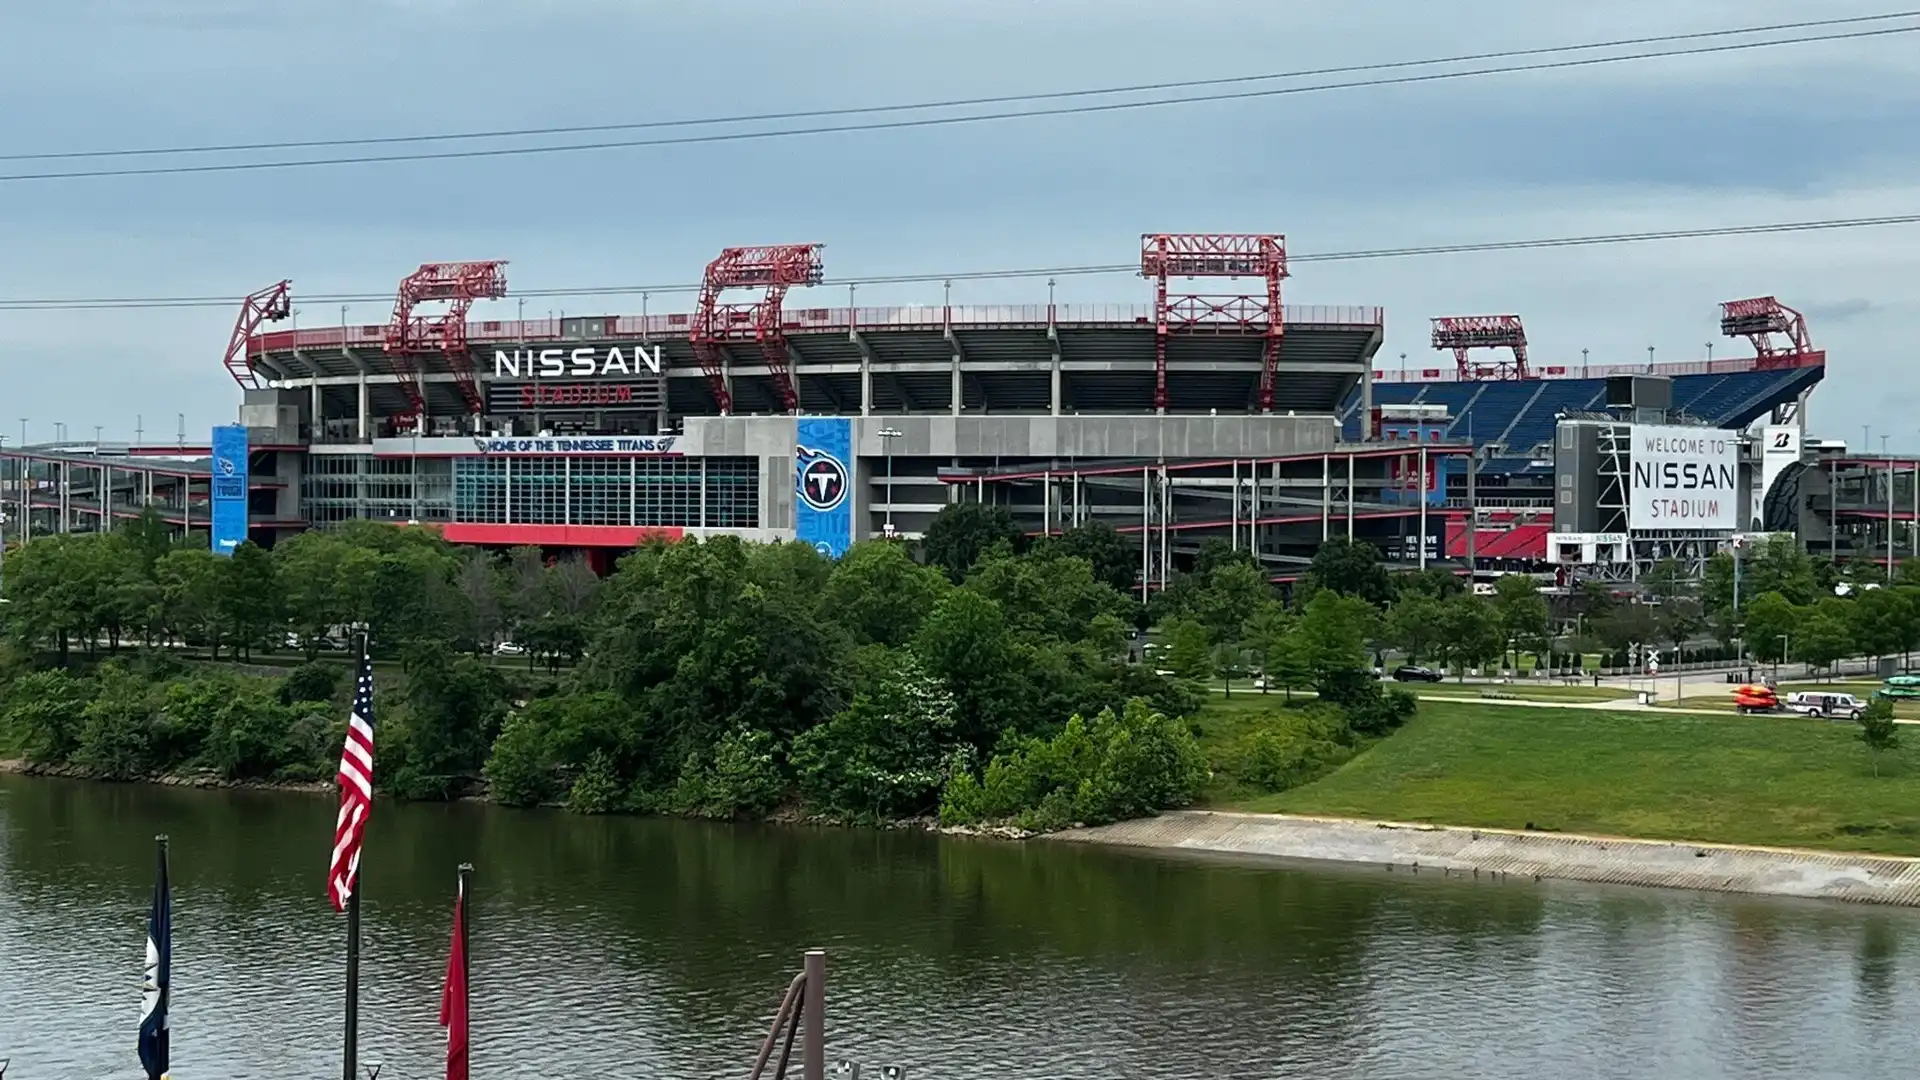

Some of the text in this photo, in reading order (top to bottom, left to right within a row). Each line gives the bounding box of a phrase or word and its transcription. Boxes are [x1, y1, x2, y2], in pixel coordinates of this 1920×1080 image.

[495, 345, 661, 377] NISSAN
[520, 384, 632, 406] STADIUM
[488, 440, 655, 451] HOME OF THE TENNESSEE TITANS
[1645, 437, 1725, 455] WELCOME TO
[1634, 461, 1734, 490] NISSAN
[1651, 498, 1719, 518] STADIUM
